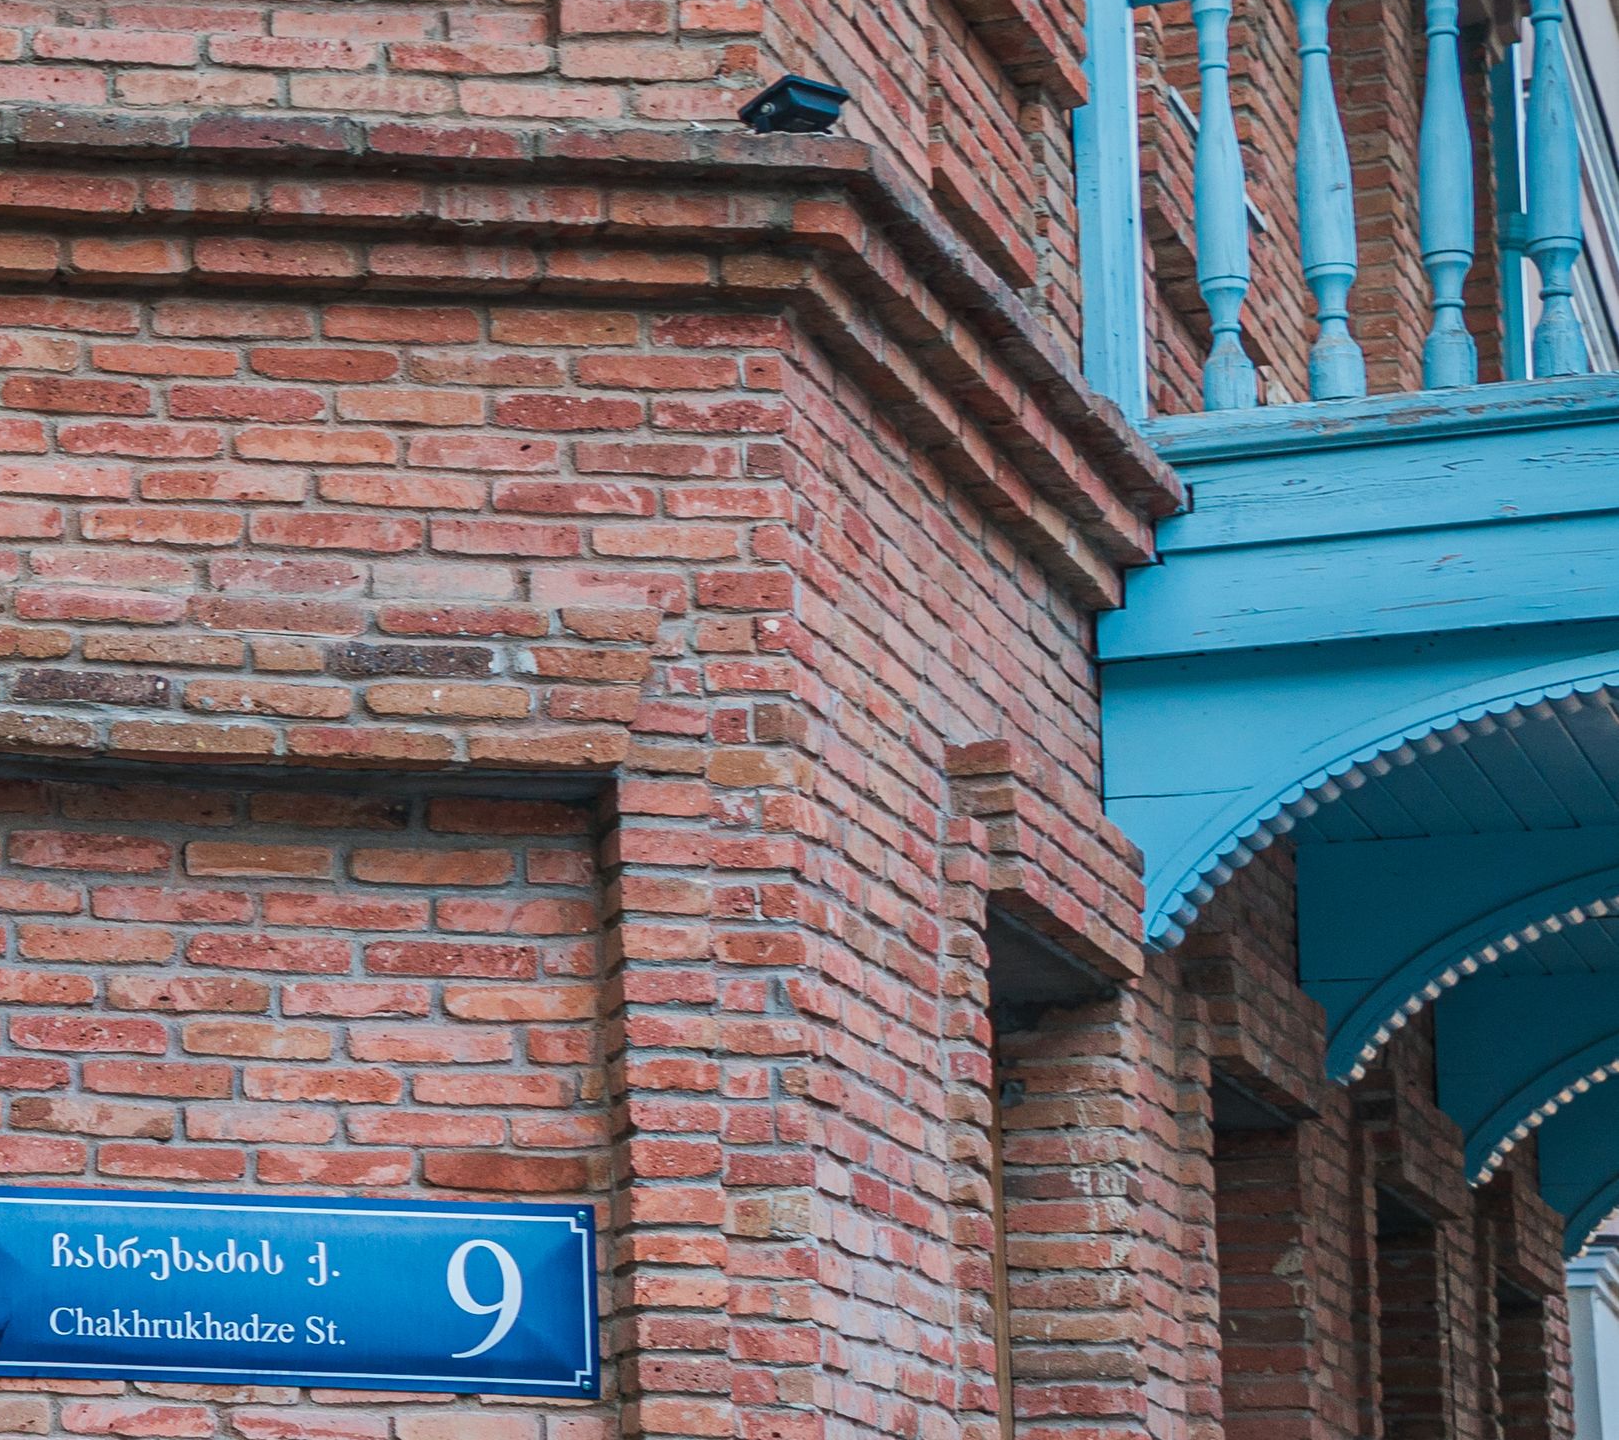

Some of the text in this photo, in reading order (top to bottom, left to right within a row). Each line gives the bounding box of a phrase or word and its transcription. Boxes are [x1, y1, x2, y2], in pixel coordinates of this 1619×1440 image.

[50, 1232, 340, 1286] ჩახრუხაძის ქ.
[49, 1307, 346, 1346] Chakhrukhadze St.
[447, 1240, 522, 1359] 9
